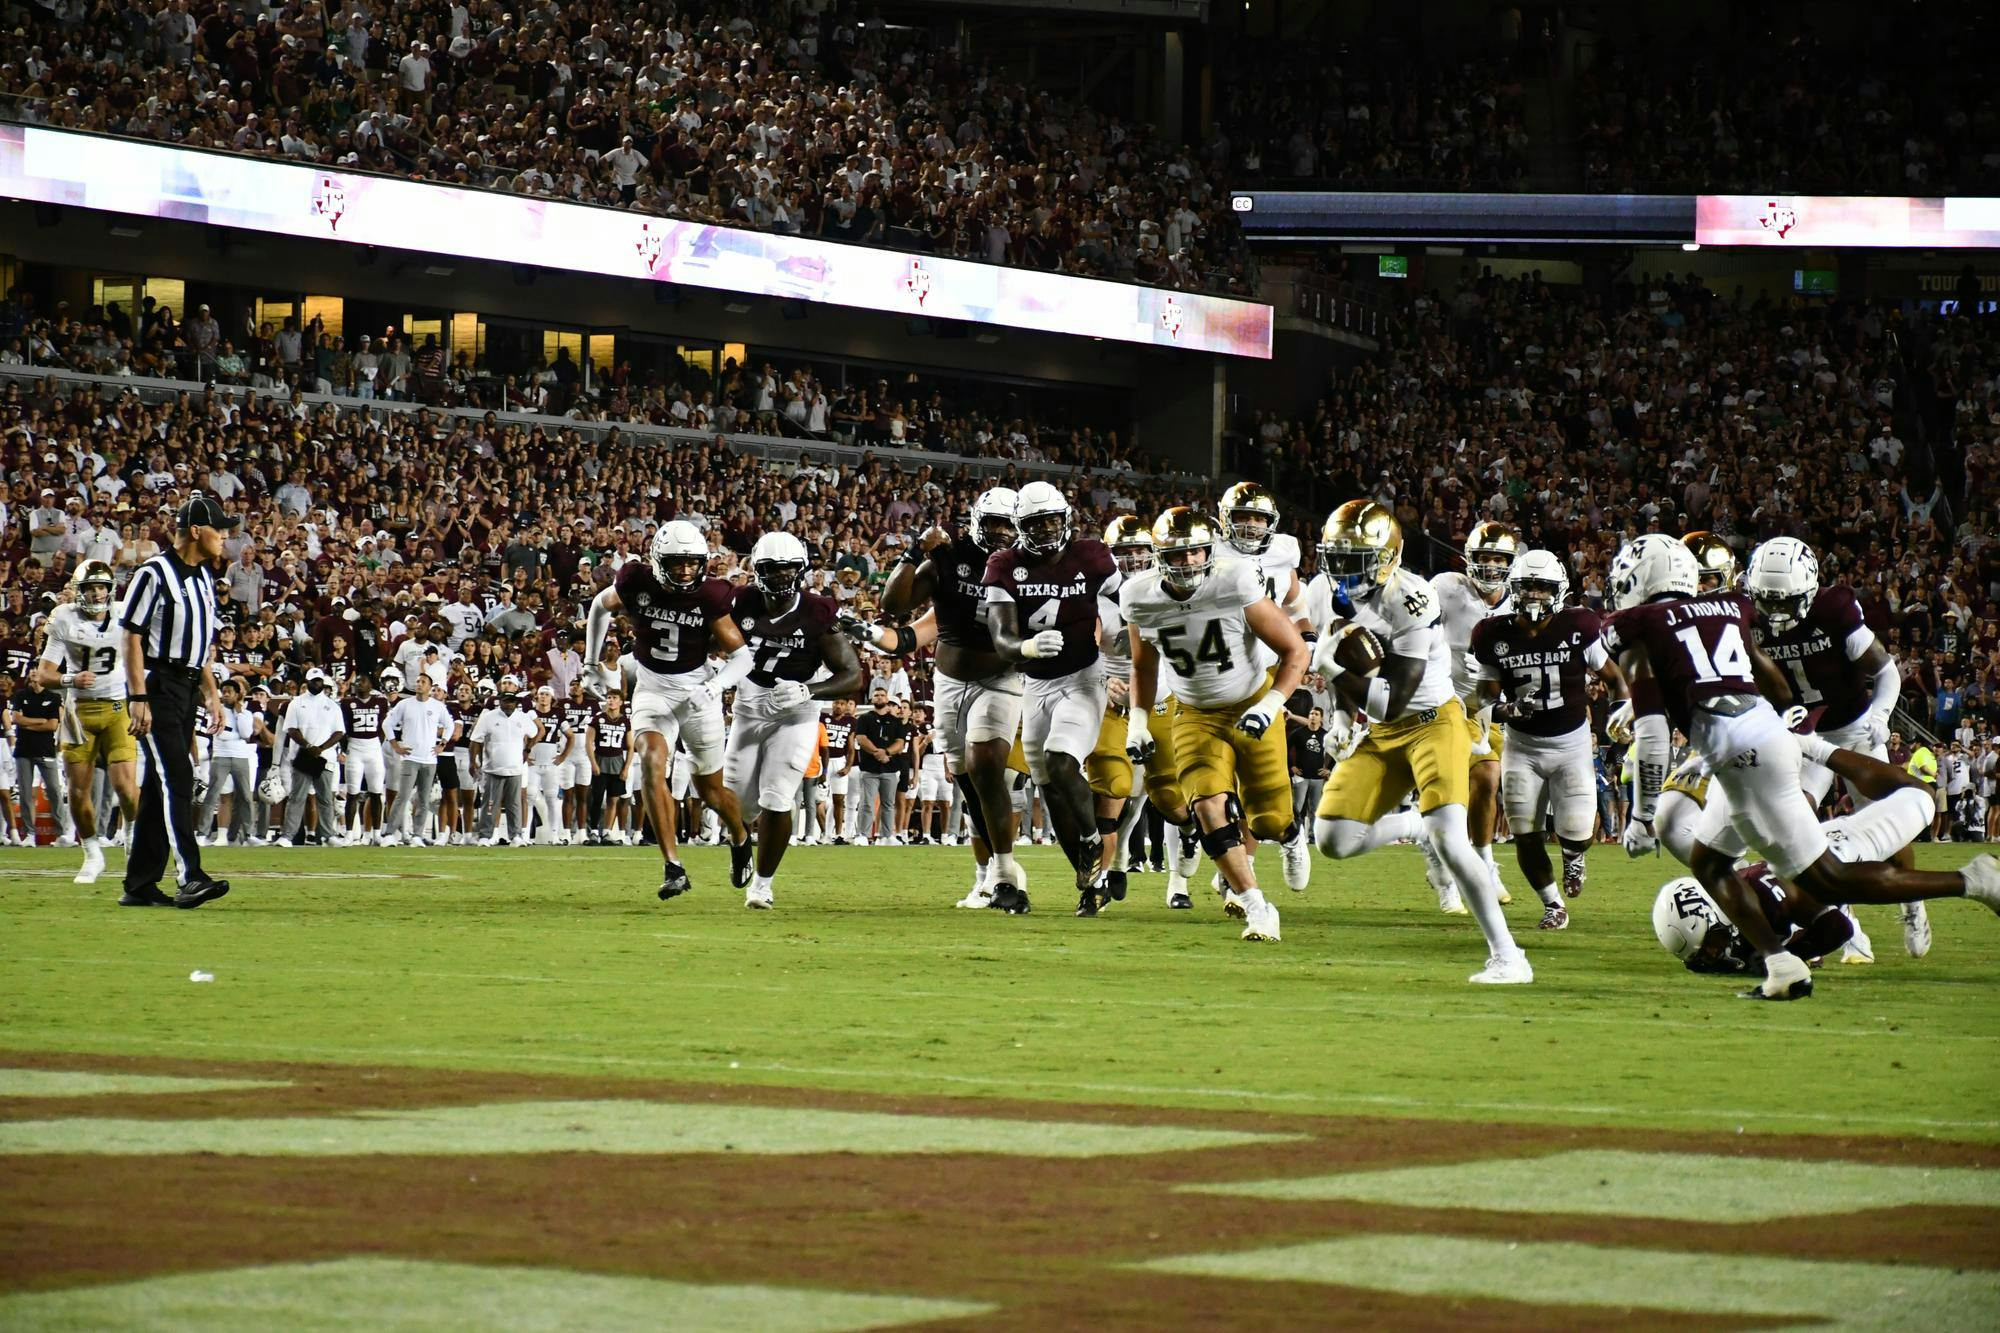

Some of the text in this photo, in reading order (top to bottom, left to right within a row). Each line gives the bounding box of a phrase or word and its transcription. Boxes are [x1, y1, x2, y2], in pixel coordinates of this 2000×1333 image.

[957, 580, 989, 599] TEXA
[1017, 582, 1086, 598] TEXAS A&M
[638, 607, 704, 628] TEXAS A&M
[1028, 598, 1061, 632] 4
[1667, 600, 1741, 626] J. THOMAS
[464, 617, 484, 633] 54
[650, 620, 680, 662] 3
[781, 637, 805, 649] A&M
[1572, 632, 1581, 645] C
[1803, 637, 1832, 657] A&M
[1943, 638, 1957, 652] 12
[1157, 618, 1235, 679] 54
[1675, 624, 1754, 684] 14
[82, 646, 117, 675] 13
[1500, 650, 1571, 669] TEXAS A&M
[1513, 665, 1565, 711] 21
[1787, 660, 1823, 703] 1
[353, 714, 378, 732] 29
[545, 723, 557, 742] 7
[600, 729, 625, 748] 30
